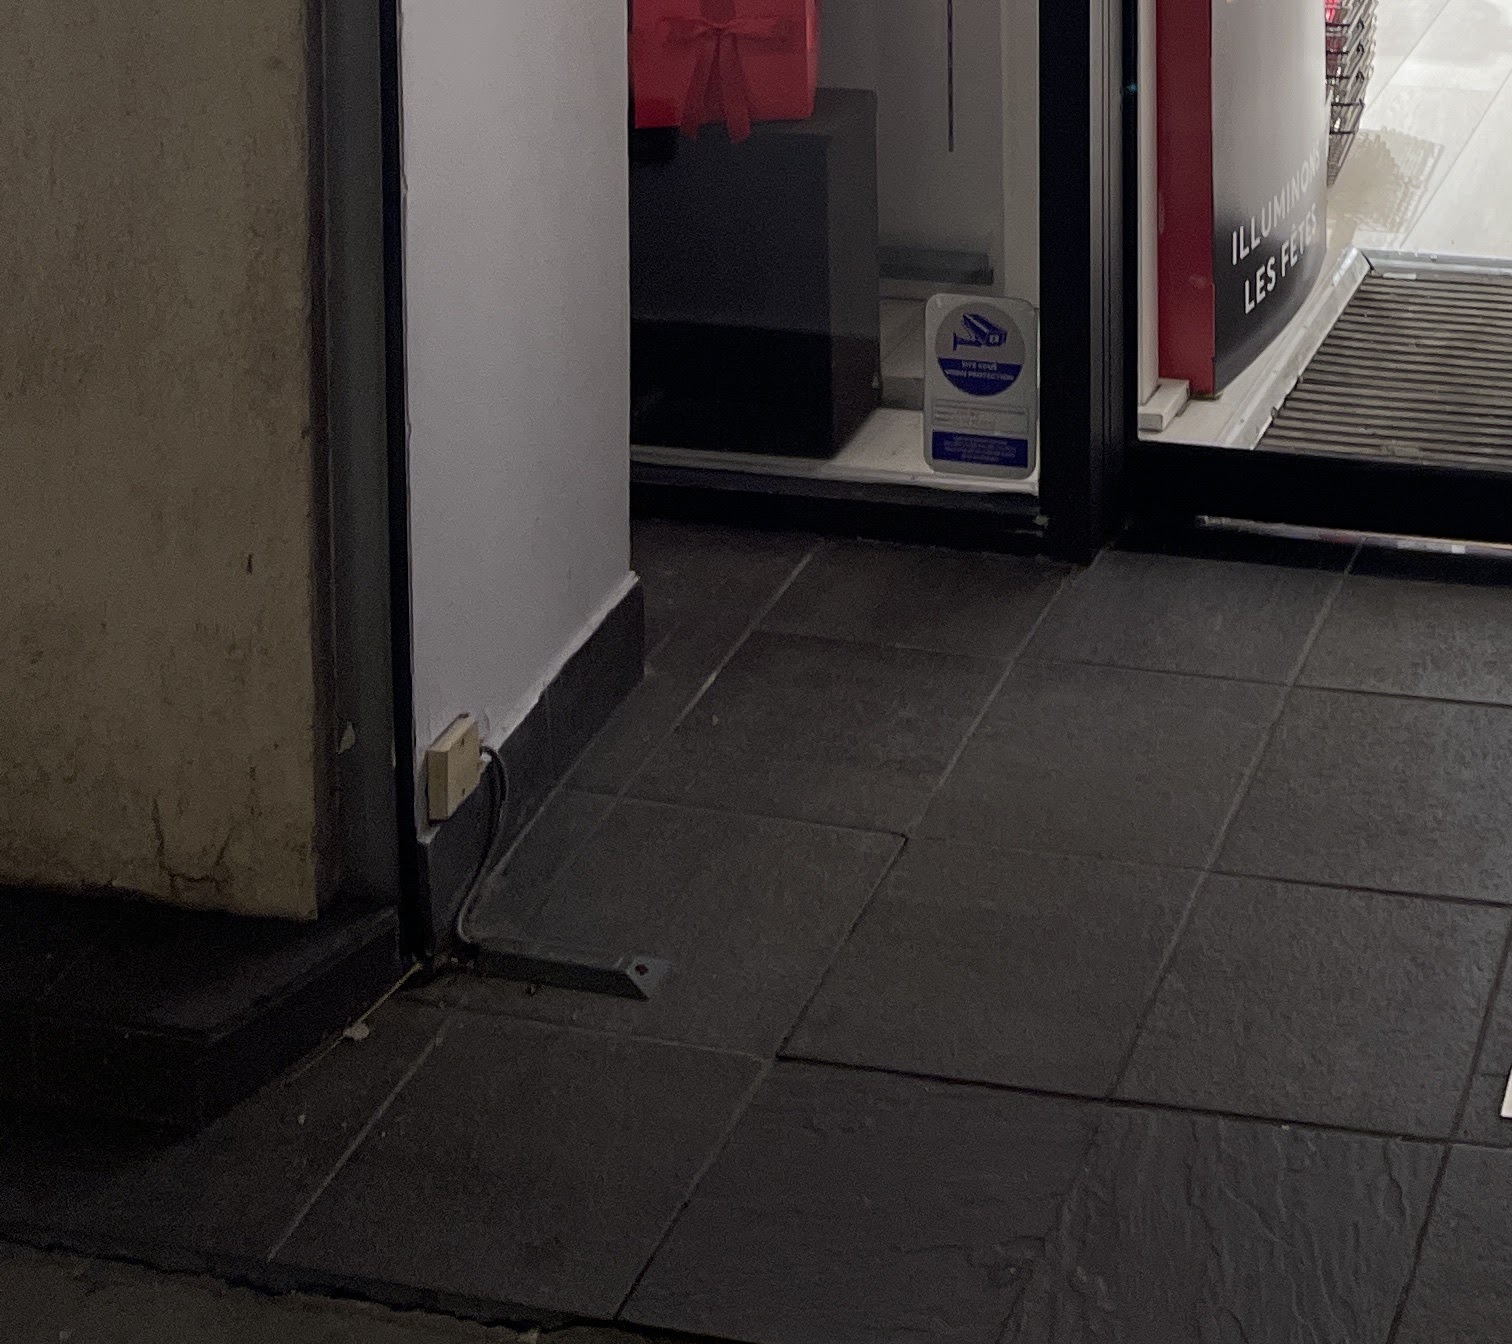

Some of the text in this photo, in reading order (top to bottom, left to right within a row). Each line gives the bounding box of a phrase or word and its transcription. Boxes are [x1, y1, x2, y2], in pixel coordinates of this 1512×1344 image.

[1232, 141, 1320, 266] ILLUMINONS
[1245, 203, 1317, 314] LES FÊTES
